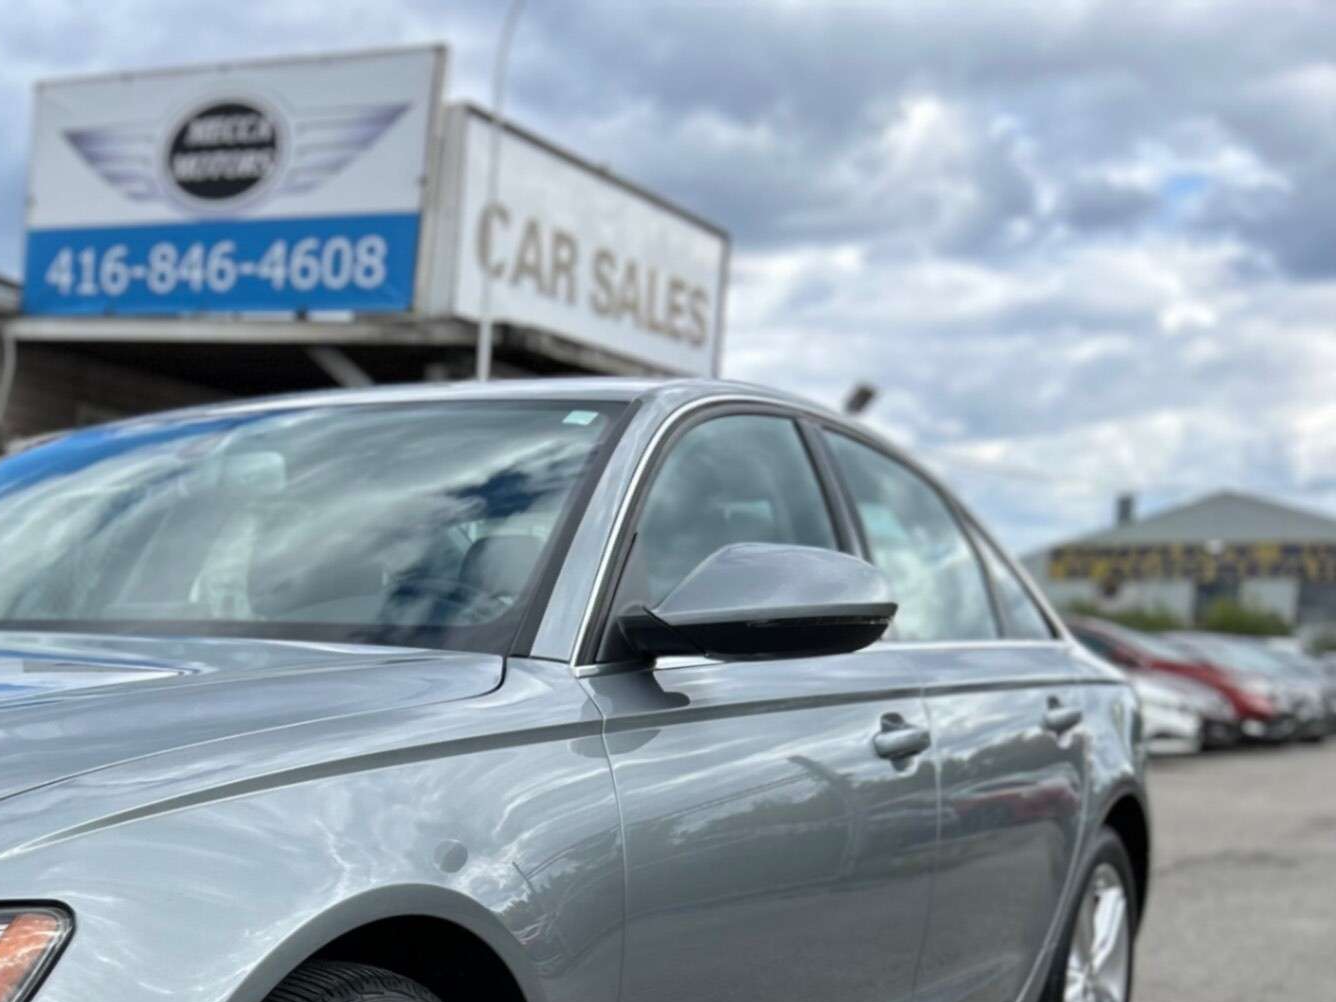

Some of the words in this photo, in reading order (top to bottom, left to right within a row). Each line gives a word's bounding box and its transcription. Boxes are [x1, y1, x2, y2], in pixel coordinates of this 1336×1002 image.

[46, 236, 388, 296] 416-846-4608
[478, 203, 580, 306] CAR
[590, 248, 710, 349] SALES
